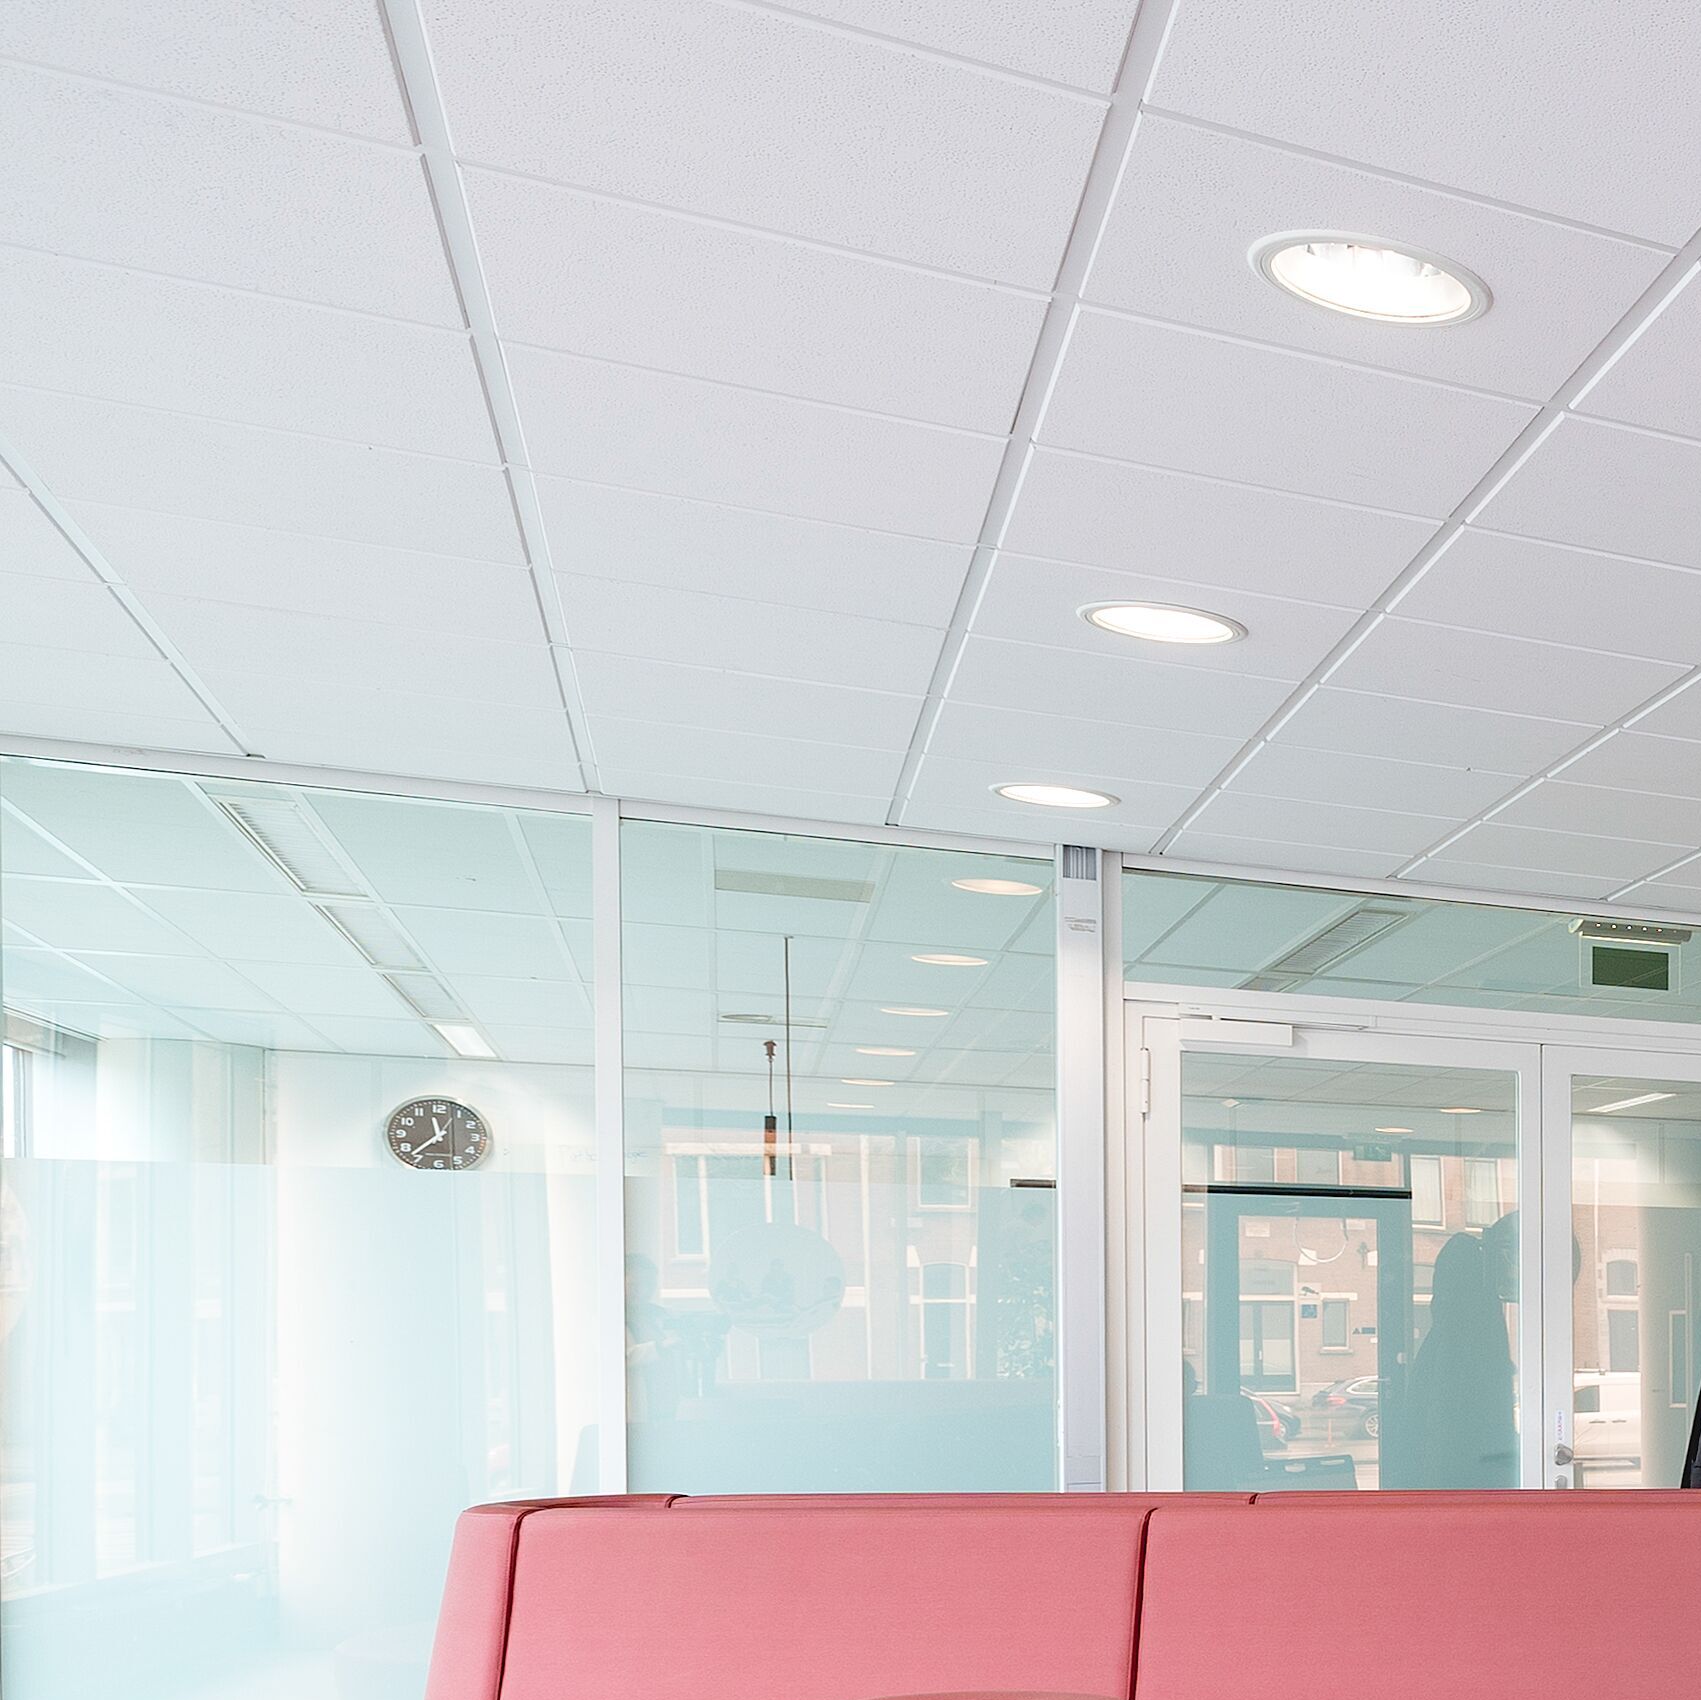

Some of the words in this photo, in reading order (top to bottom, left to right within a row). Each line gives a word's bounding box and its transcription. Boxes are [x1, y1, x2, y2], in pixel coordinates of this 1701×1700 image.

[414, 1107, 424, 1117] 11
[432, 1104, 447, 1114] 12
[400, 1117, 415, 1126] 10
[465, 1120, 477, 1129] 2
[395, 1129, 407, 1138] 9
[470, 1133, 480, 1142] 3
[400, 1142, 412, 1152] 8
[464, 1145, 475, 1154] 4
[413, 1154, 424, 1163] 7
[452, 1155, 463, 1165] 5
[433, 1159, 444, 1168] 6
